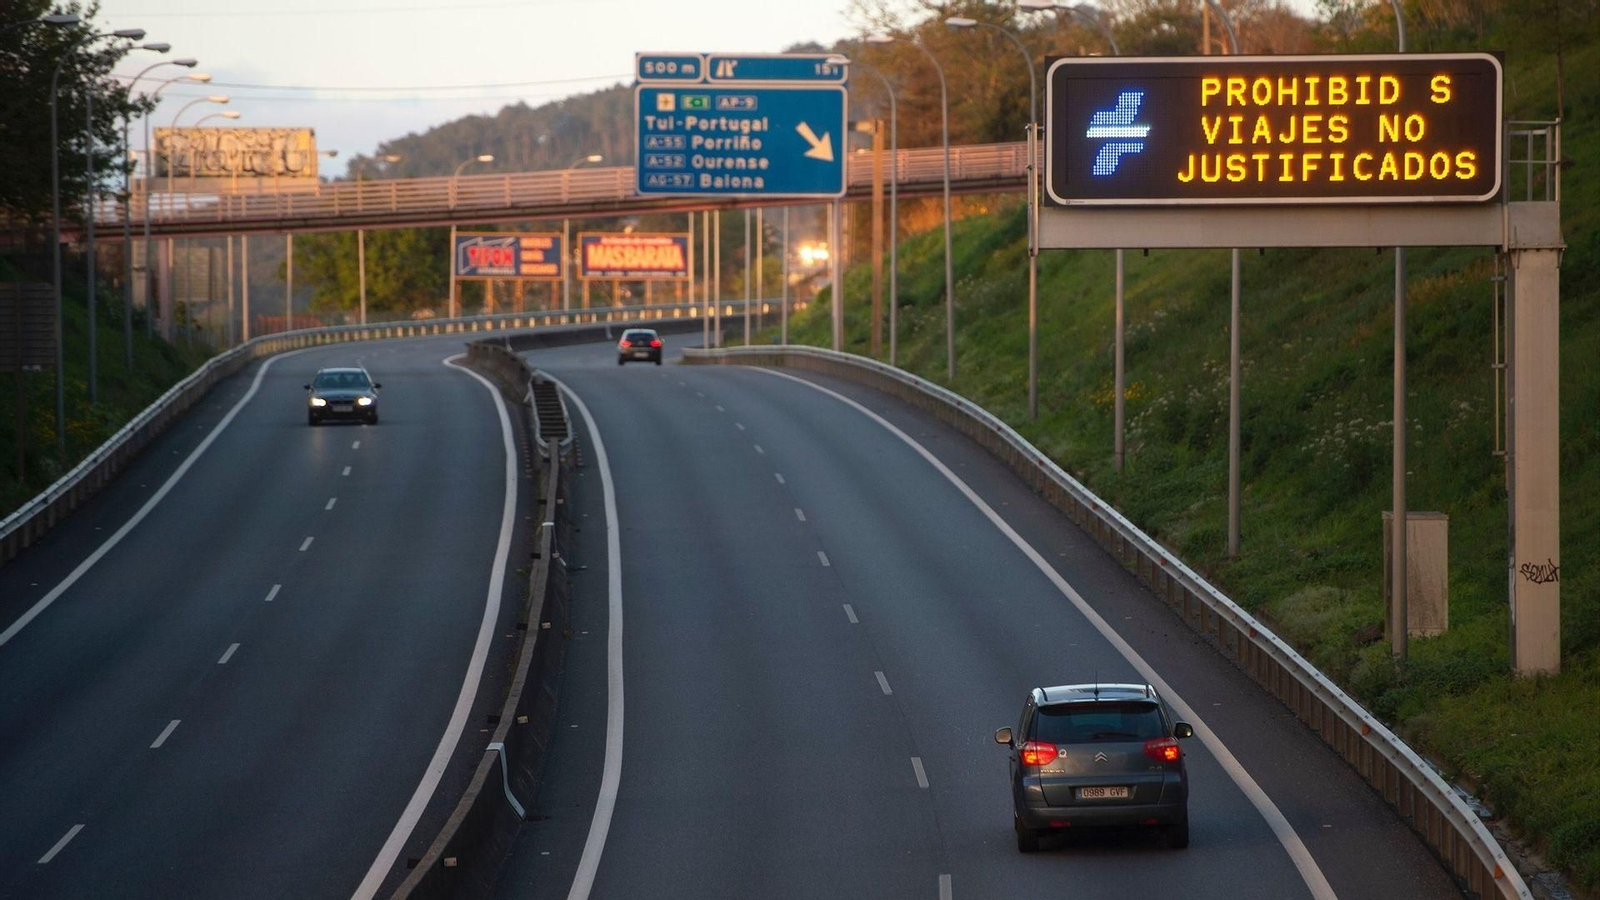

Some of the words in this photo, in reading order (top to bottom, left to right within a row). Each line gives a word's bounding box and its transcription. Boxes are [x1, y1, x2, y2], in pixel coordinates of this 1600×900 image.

[645, 61, 677, 74] 500
[681, 64, 695, 74] m
[719, 96, 755, 109] AP-9
[644, 115, 768, 134] Tui-Portugal
[1201, 115, 1350, 145] VIAJES
[1378, 114, 1426, 143] NO
[691, 134, 762, 150] Porriño
[647, 155, 684, 168] A-52
[691, 154, 769, 169] Ourense
[1177, 151, 1477, 183] JUSTIFICADOS
[700, 173, 764, 189] Baiona
[1083, 788, 1105, 797] 0989
[1110, 787, 1126, 796] GVF
